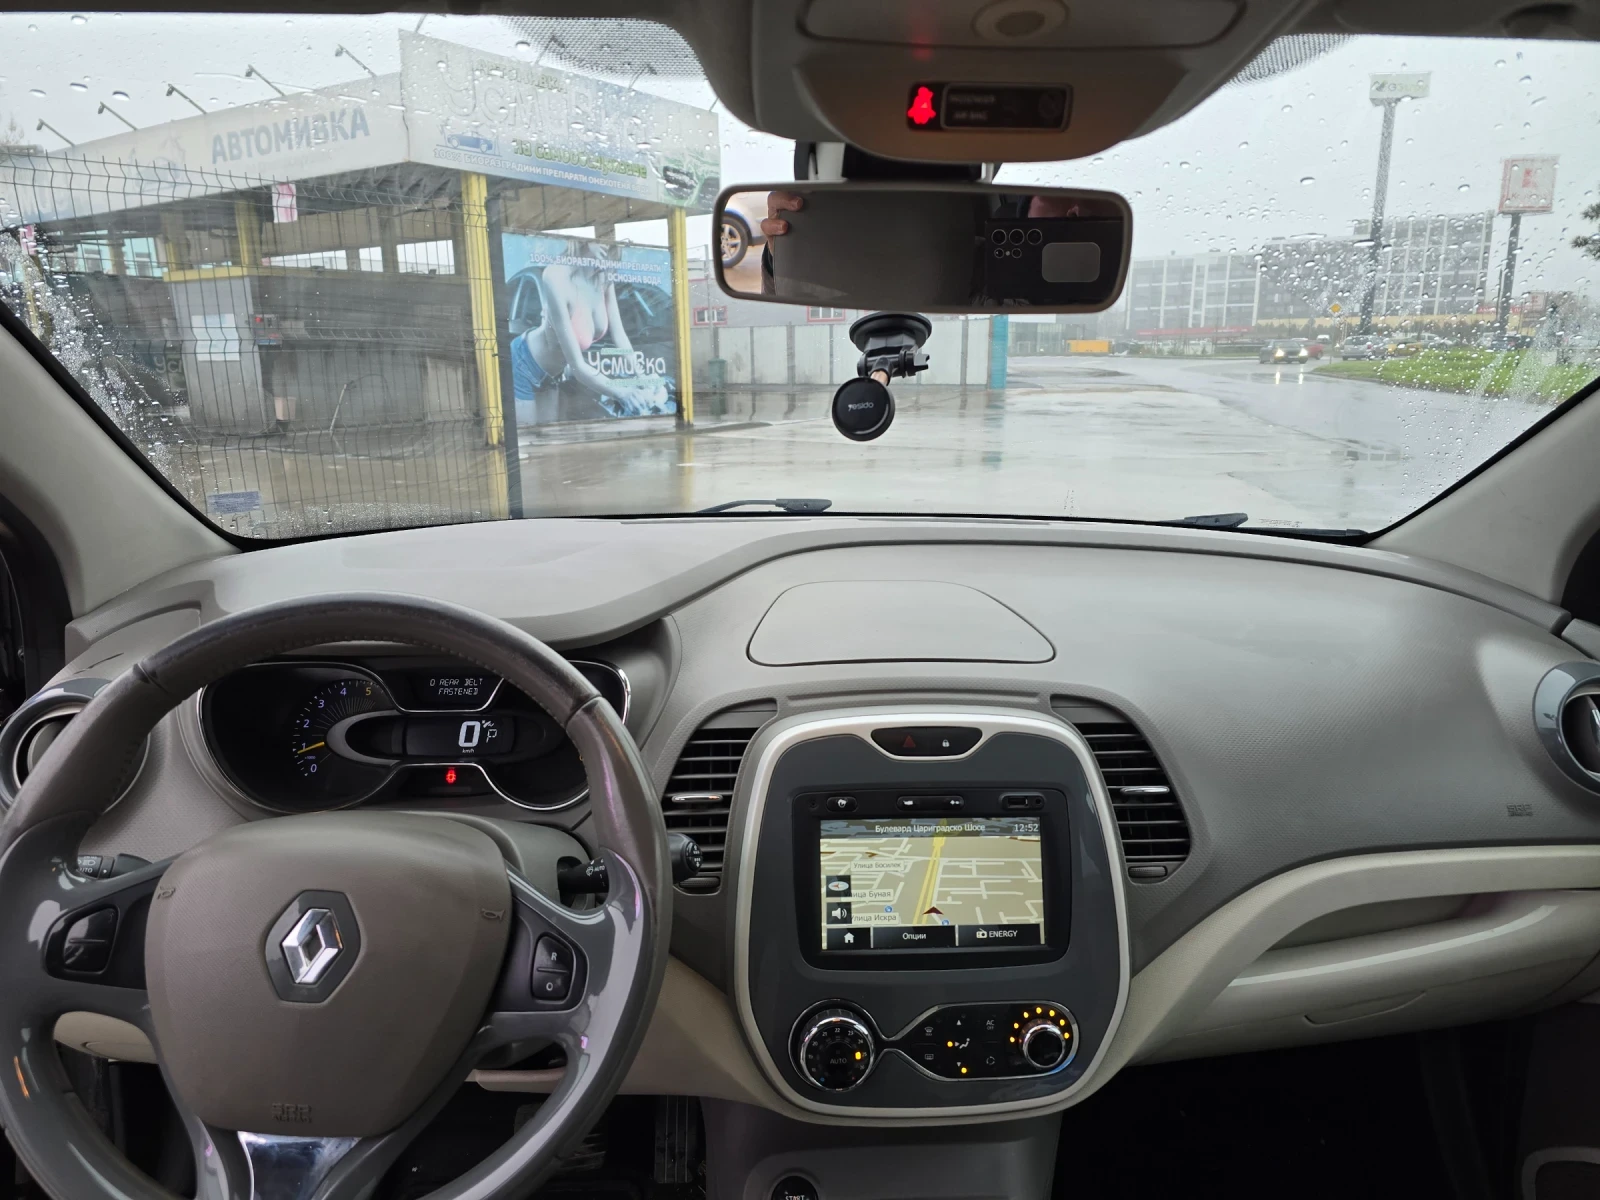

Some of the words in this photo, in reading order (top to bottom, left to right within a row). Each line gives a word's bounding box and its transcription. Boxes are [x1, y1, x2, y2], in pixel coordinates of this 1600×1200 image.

[212, 104, 370, 164] АВТОМИВКА
[432, 148, 462, 163] 100%
[464, 155, 541, 175] БИОРАЗГРАДИМИ
[543, 168, 588, 183] ПРЕПАРАТИ
[530, 253, 553, 264] 100%
[622, 262, 661, 273] ПРЕПАРАТИ
[642, 276, 661, 286] ВОДА
[439, 678, 459, 686] REAR
[464, 678, 483, 686] BELT
[339, 687, 347, 696] 4
[365, 687, 372, 696] 5
[317, 699, 325, 708] 3
[303, 719, 310, 728] 2
[458, 720, 481, 747] 0
[486, 728, 497, 743] P
[301, 742, 306, 751] 1
[310, 763, 317, 772] 0
[875, 824, 911, 834] Булевард
[913, 824, 963, 834] Цариградско
[964, 824, 985, 832] Шосе
[1014, 823, 1039, 832] 12:52
[869, 891, 891, 899] Буная
[874, 914, 896, 922] Искра
[902, 932, 926, 940] Опции
[989, 930, 1018, 938] ENERGY
[551, 952, 557, 961] R
